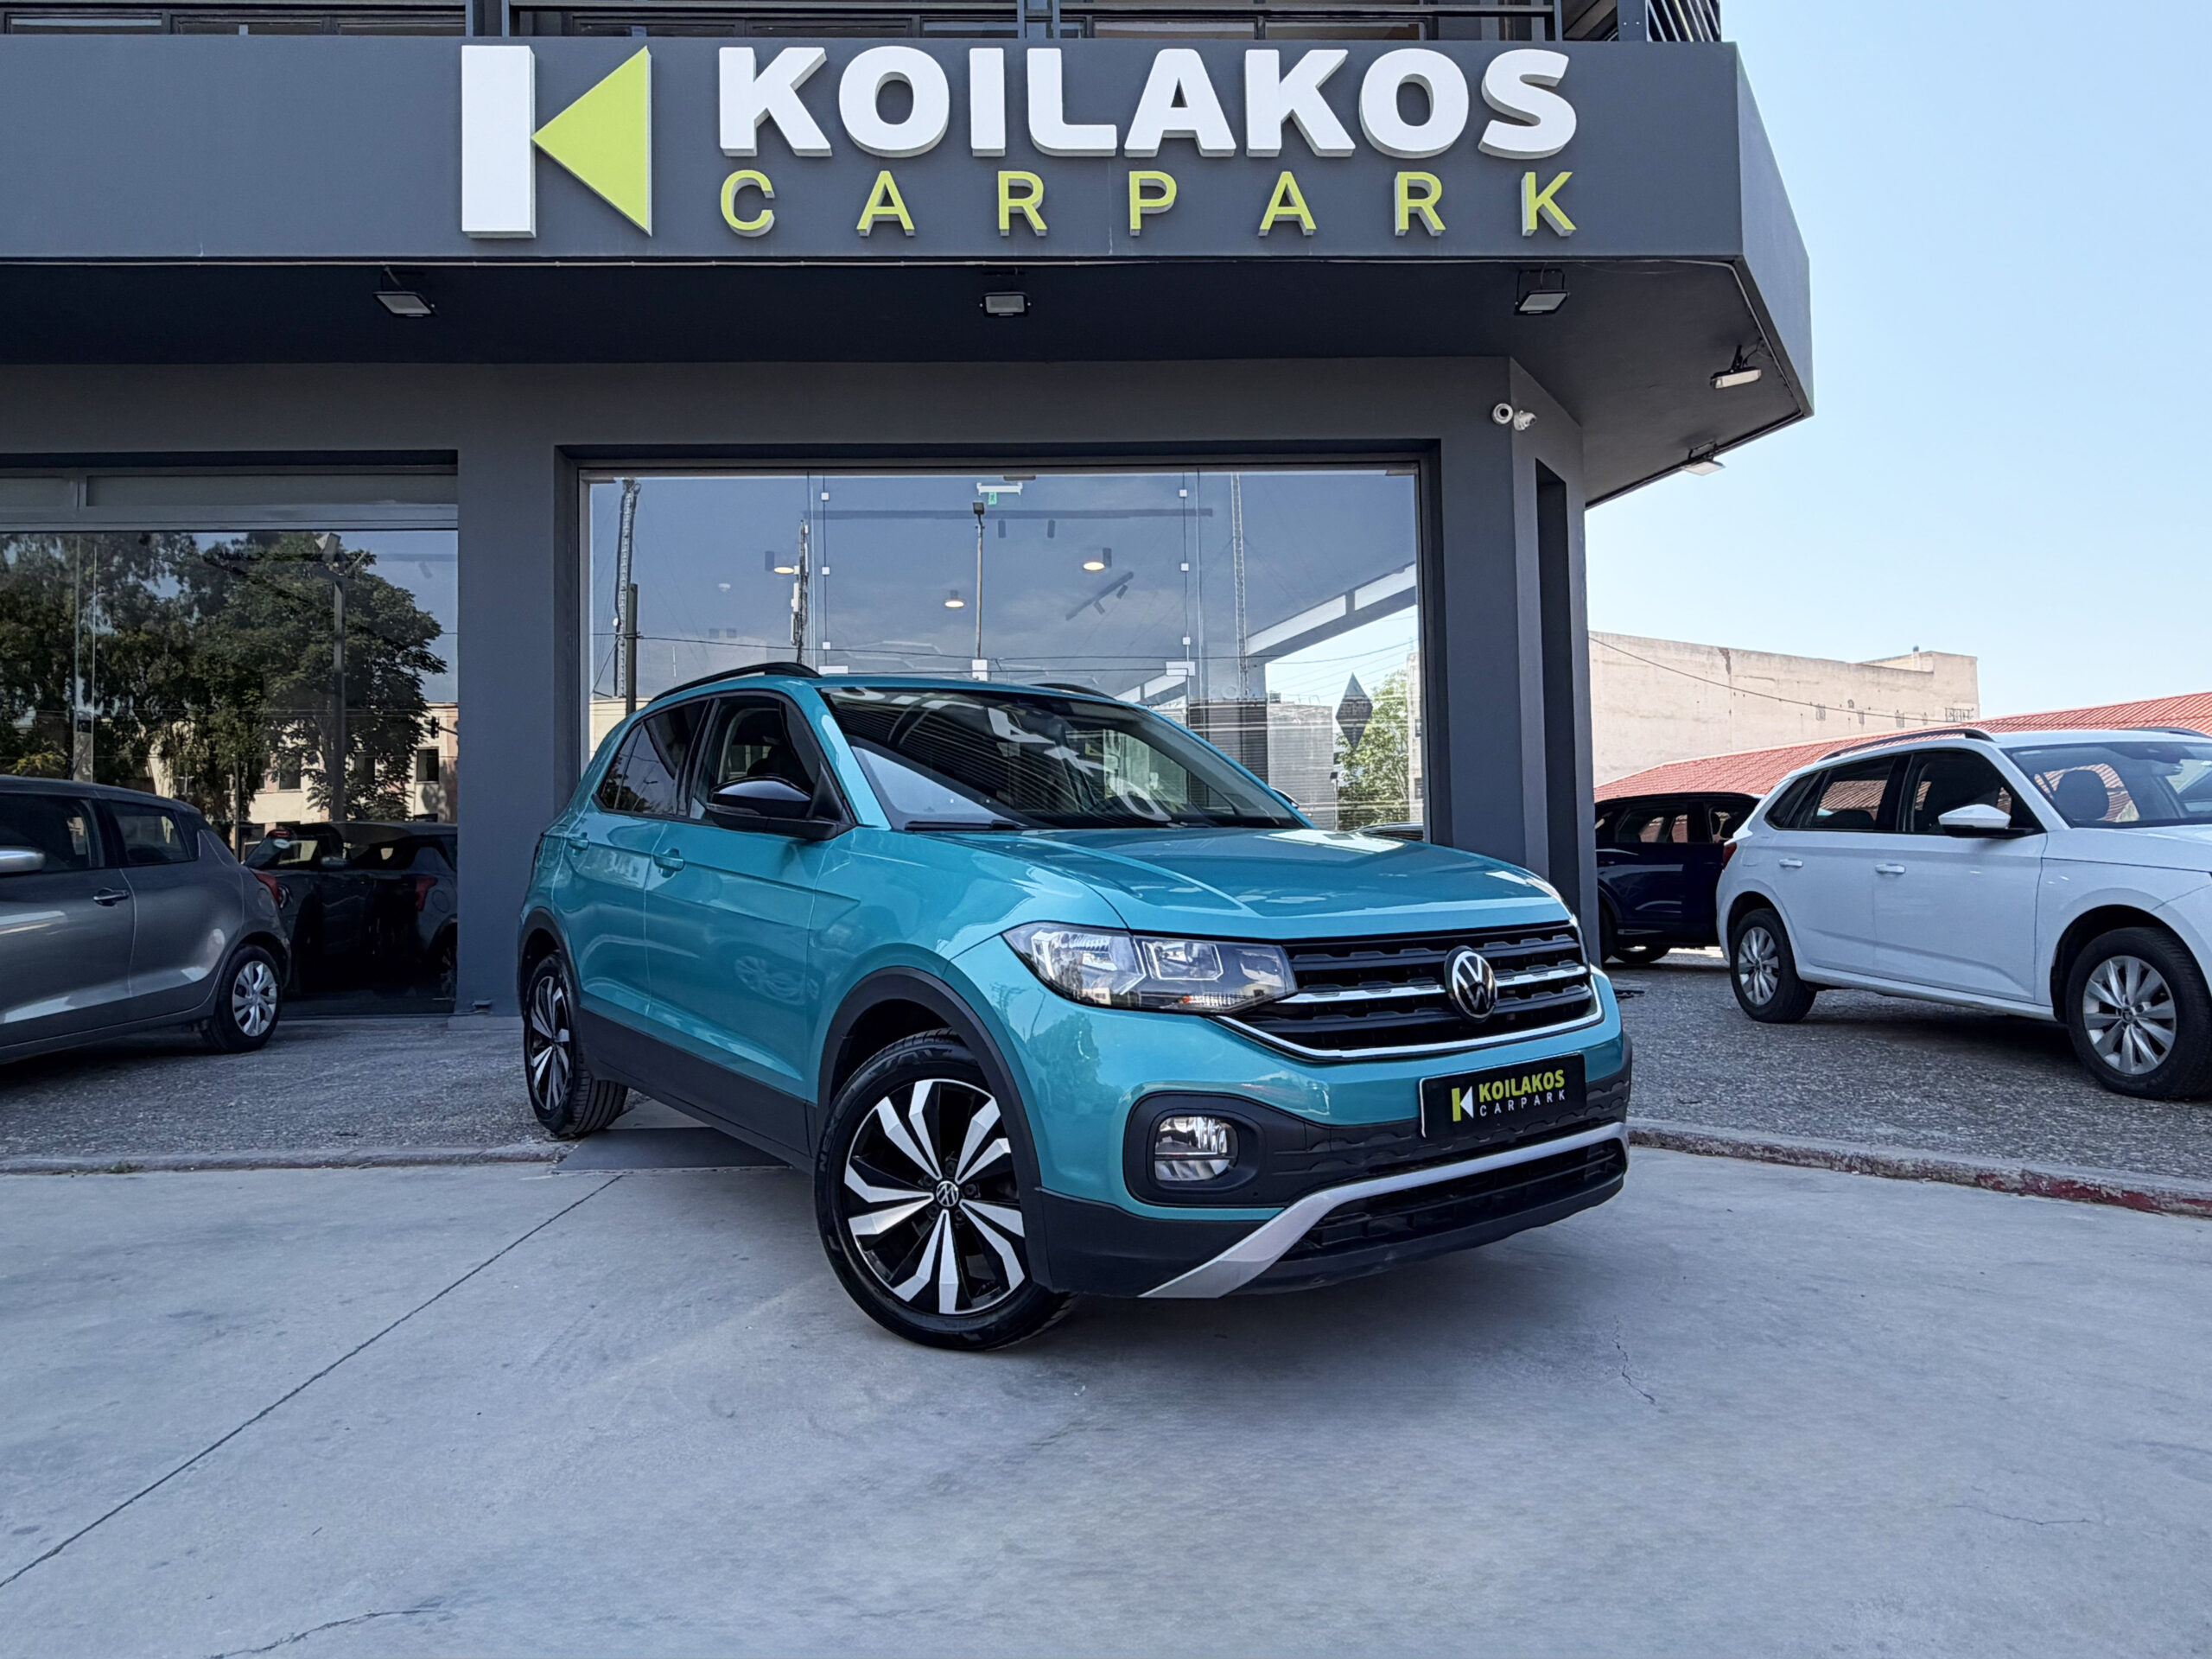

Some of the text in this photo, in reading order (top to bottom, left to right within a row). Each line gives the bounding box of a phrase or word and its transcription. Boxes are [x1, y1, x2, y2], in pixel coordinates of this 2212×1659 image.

[719, 46, 1577, 159] KOILAKOS
[720, 169, 1577, 238] CARPARK
[1478, 1069, 1566, 1103] KOILAKOS
[1479, 1089, 1566, 1117] CARPARK
